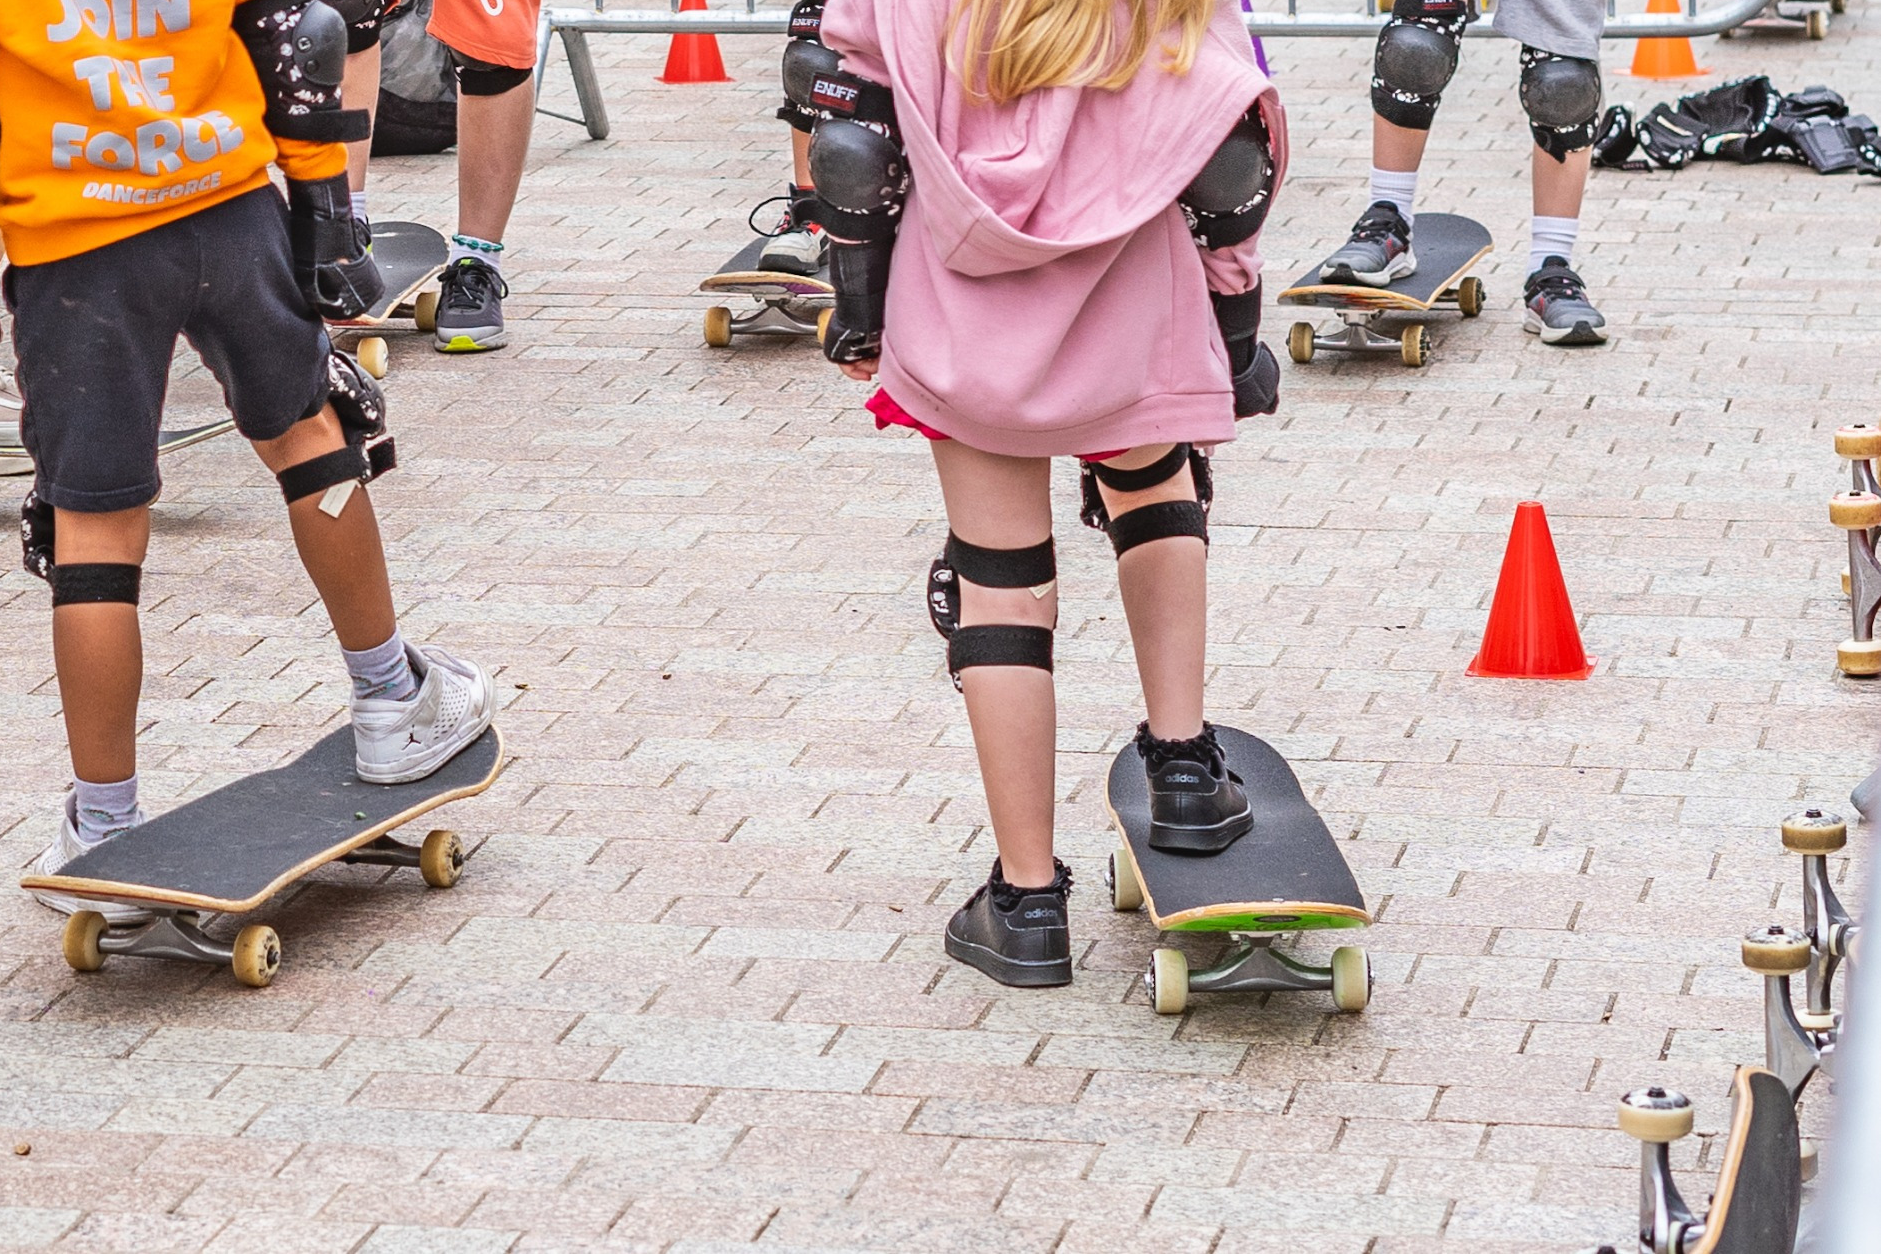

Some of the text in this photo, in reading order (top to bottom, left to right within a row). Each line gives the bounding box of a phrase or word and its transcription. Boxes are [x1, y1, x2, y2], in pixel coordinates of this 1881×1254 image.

[73, 55, 175, 112] THE
[813, 80, 858, 101] ENUFF
[51, 110, 244, 176] FORCE
[82, 171, 222, 205] DANCEFORCE
[1165, 773, 1200, 784] adidas
